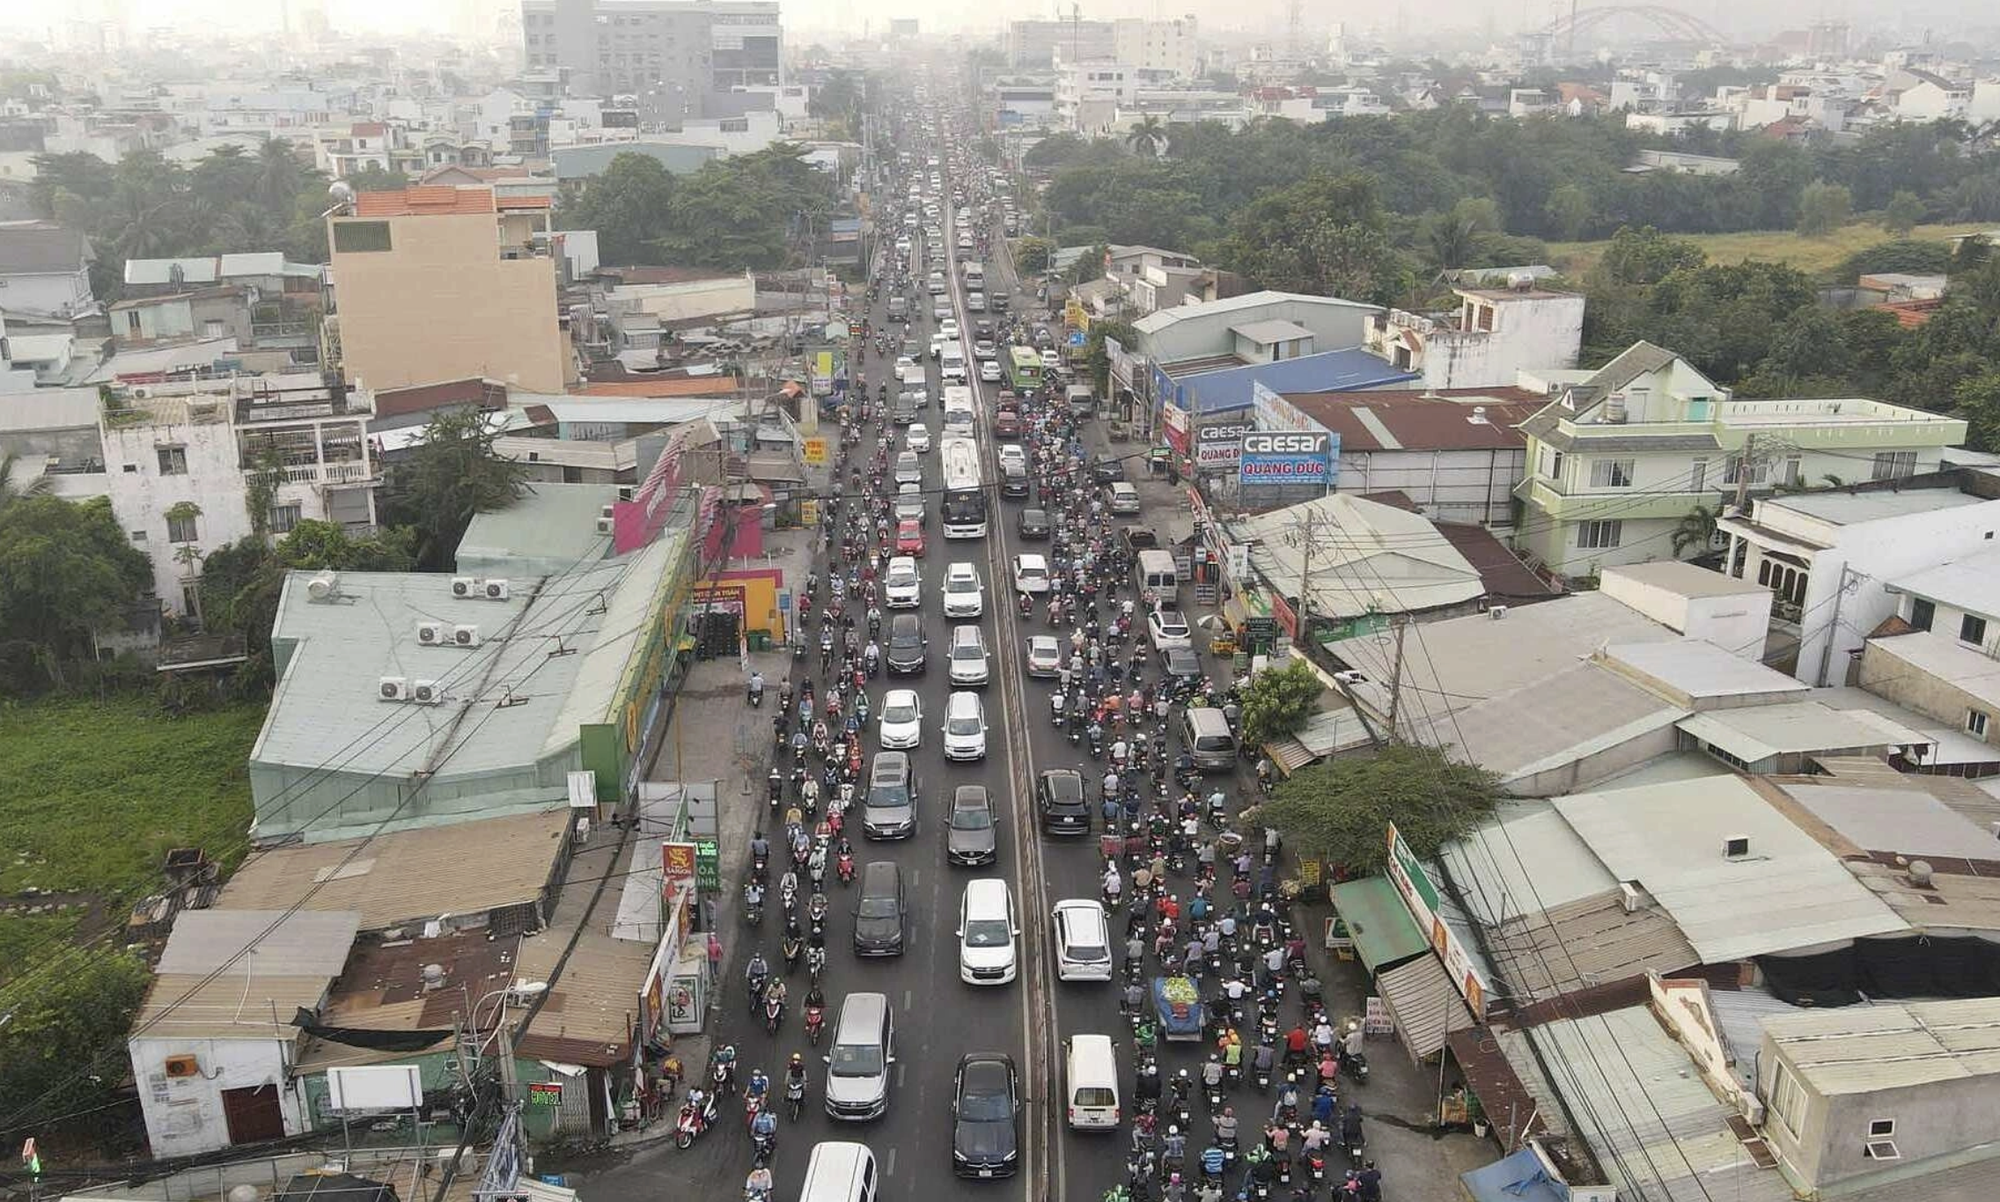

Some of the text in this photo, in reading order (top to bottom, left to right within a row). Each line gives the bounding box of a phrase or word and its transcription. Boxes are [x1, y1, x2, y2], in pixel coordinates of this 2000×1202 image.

[1244, 435, 1326, 452] caesar
[1201, 449, 1231, 460] QUANG
[1244, 463, 1292, 475] QUANG
